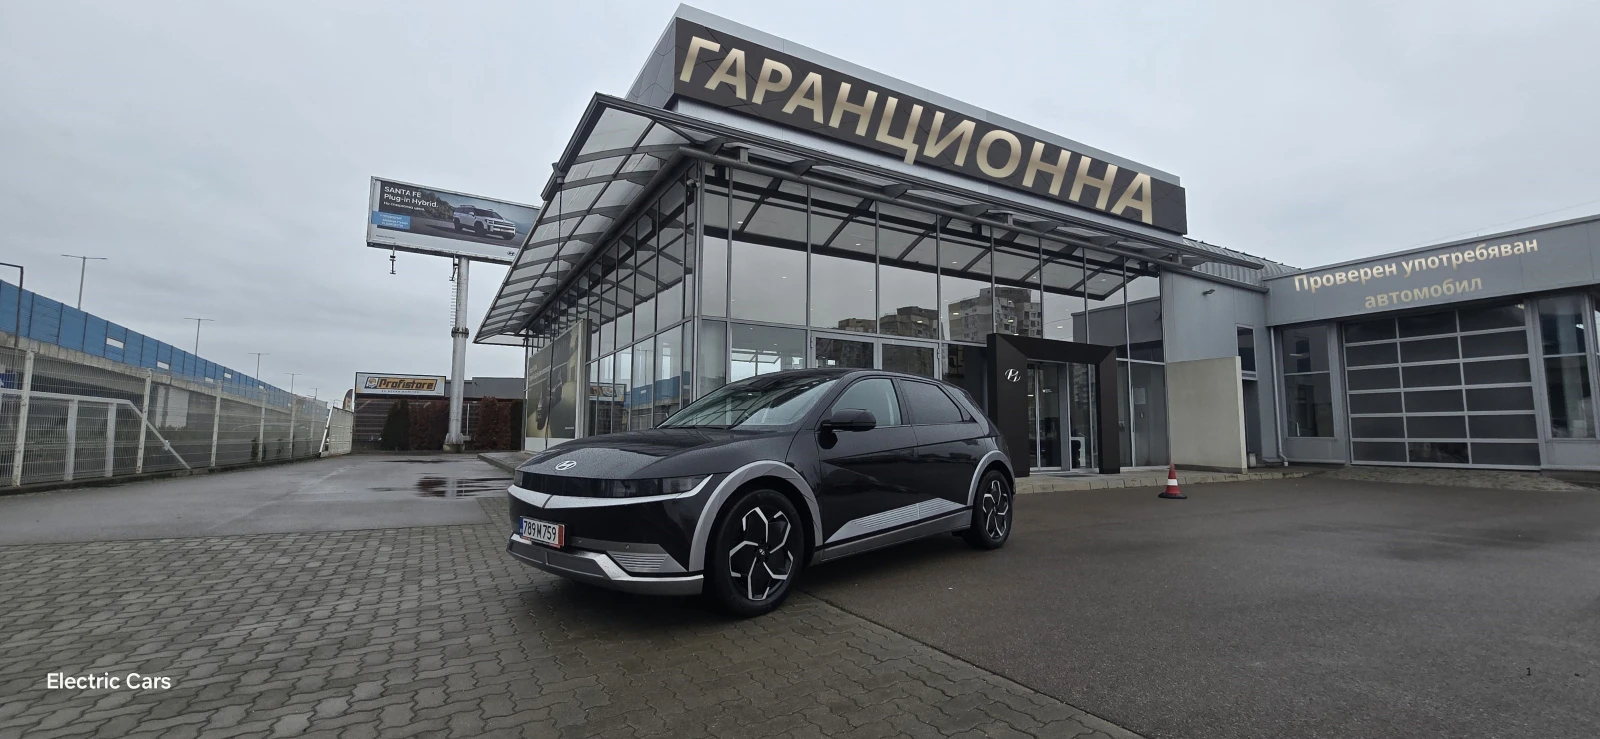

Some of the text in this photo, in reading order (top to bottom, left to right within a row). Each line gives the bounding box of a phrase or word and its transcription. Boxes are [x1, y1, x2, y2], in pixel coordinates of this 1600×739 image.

[679, 35, 1153, 226] ГАРАНЦИОННА
[384, 186, 411, 197] SANTA
[384, 193, 439, 208] Plug-in Hybrid.
[1293, 238, 1539, 294] Проверен употребяван
[1364, 275, 1483, 309] автомобил
[378, 378, 434, 390] Profistore
